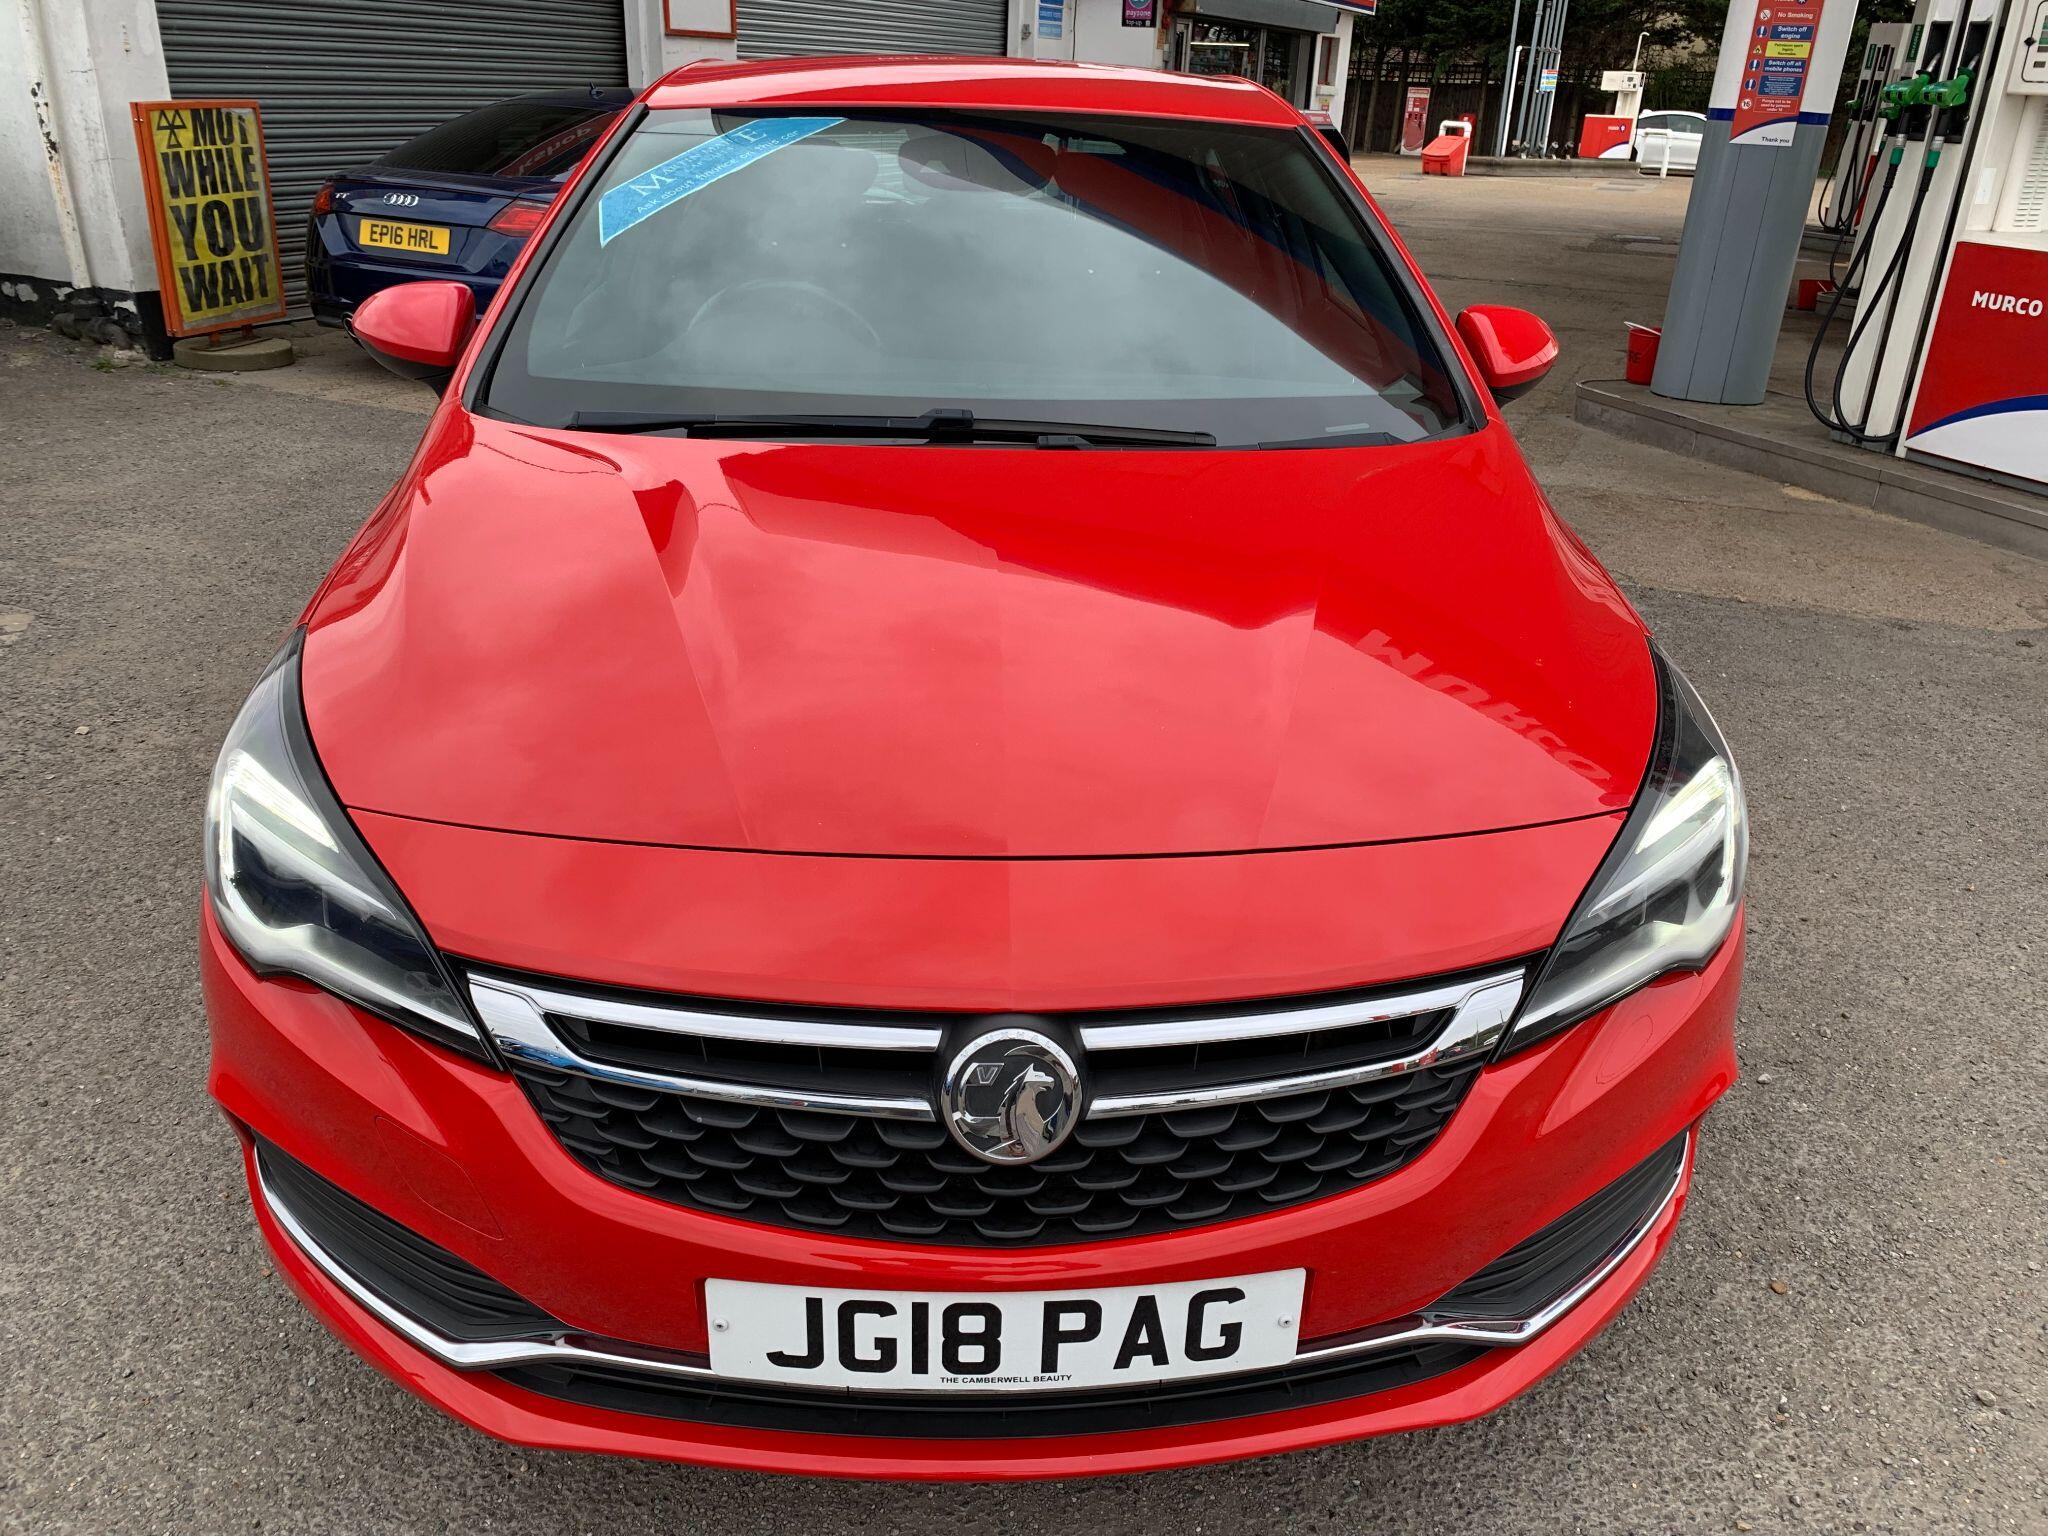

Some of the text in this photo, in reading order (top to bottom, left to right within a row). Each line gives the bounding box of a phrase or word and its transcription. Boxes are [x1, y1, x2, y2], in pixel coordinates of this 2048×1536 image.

[1126, 10, 1151, 18] payzone
[160, 147, 260, 199] WHILE
[637, 197, 661, 214] Ask
[661, 180, 695, 200] about
[695, 157, 737, 181] finance
[757, 138, 780, 152] this
[780, 130, 800, 141] car
[168, 196, 265, 261] YOU
[369, 223, 439, 250] EP16 HRL
[178, 253, 270, 313] WAIT
[1971, 290, 2044, 318] MURCO
[765, 1287, 1247, 1375] JG18 PAG
[940, 1374, 1073, 1384] THE CAMBERWELL BEAUTY
